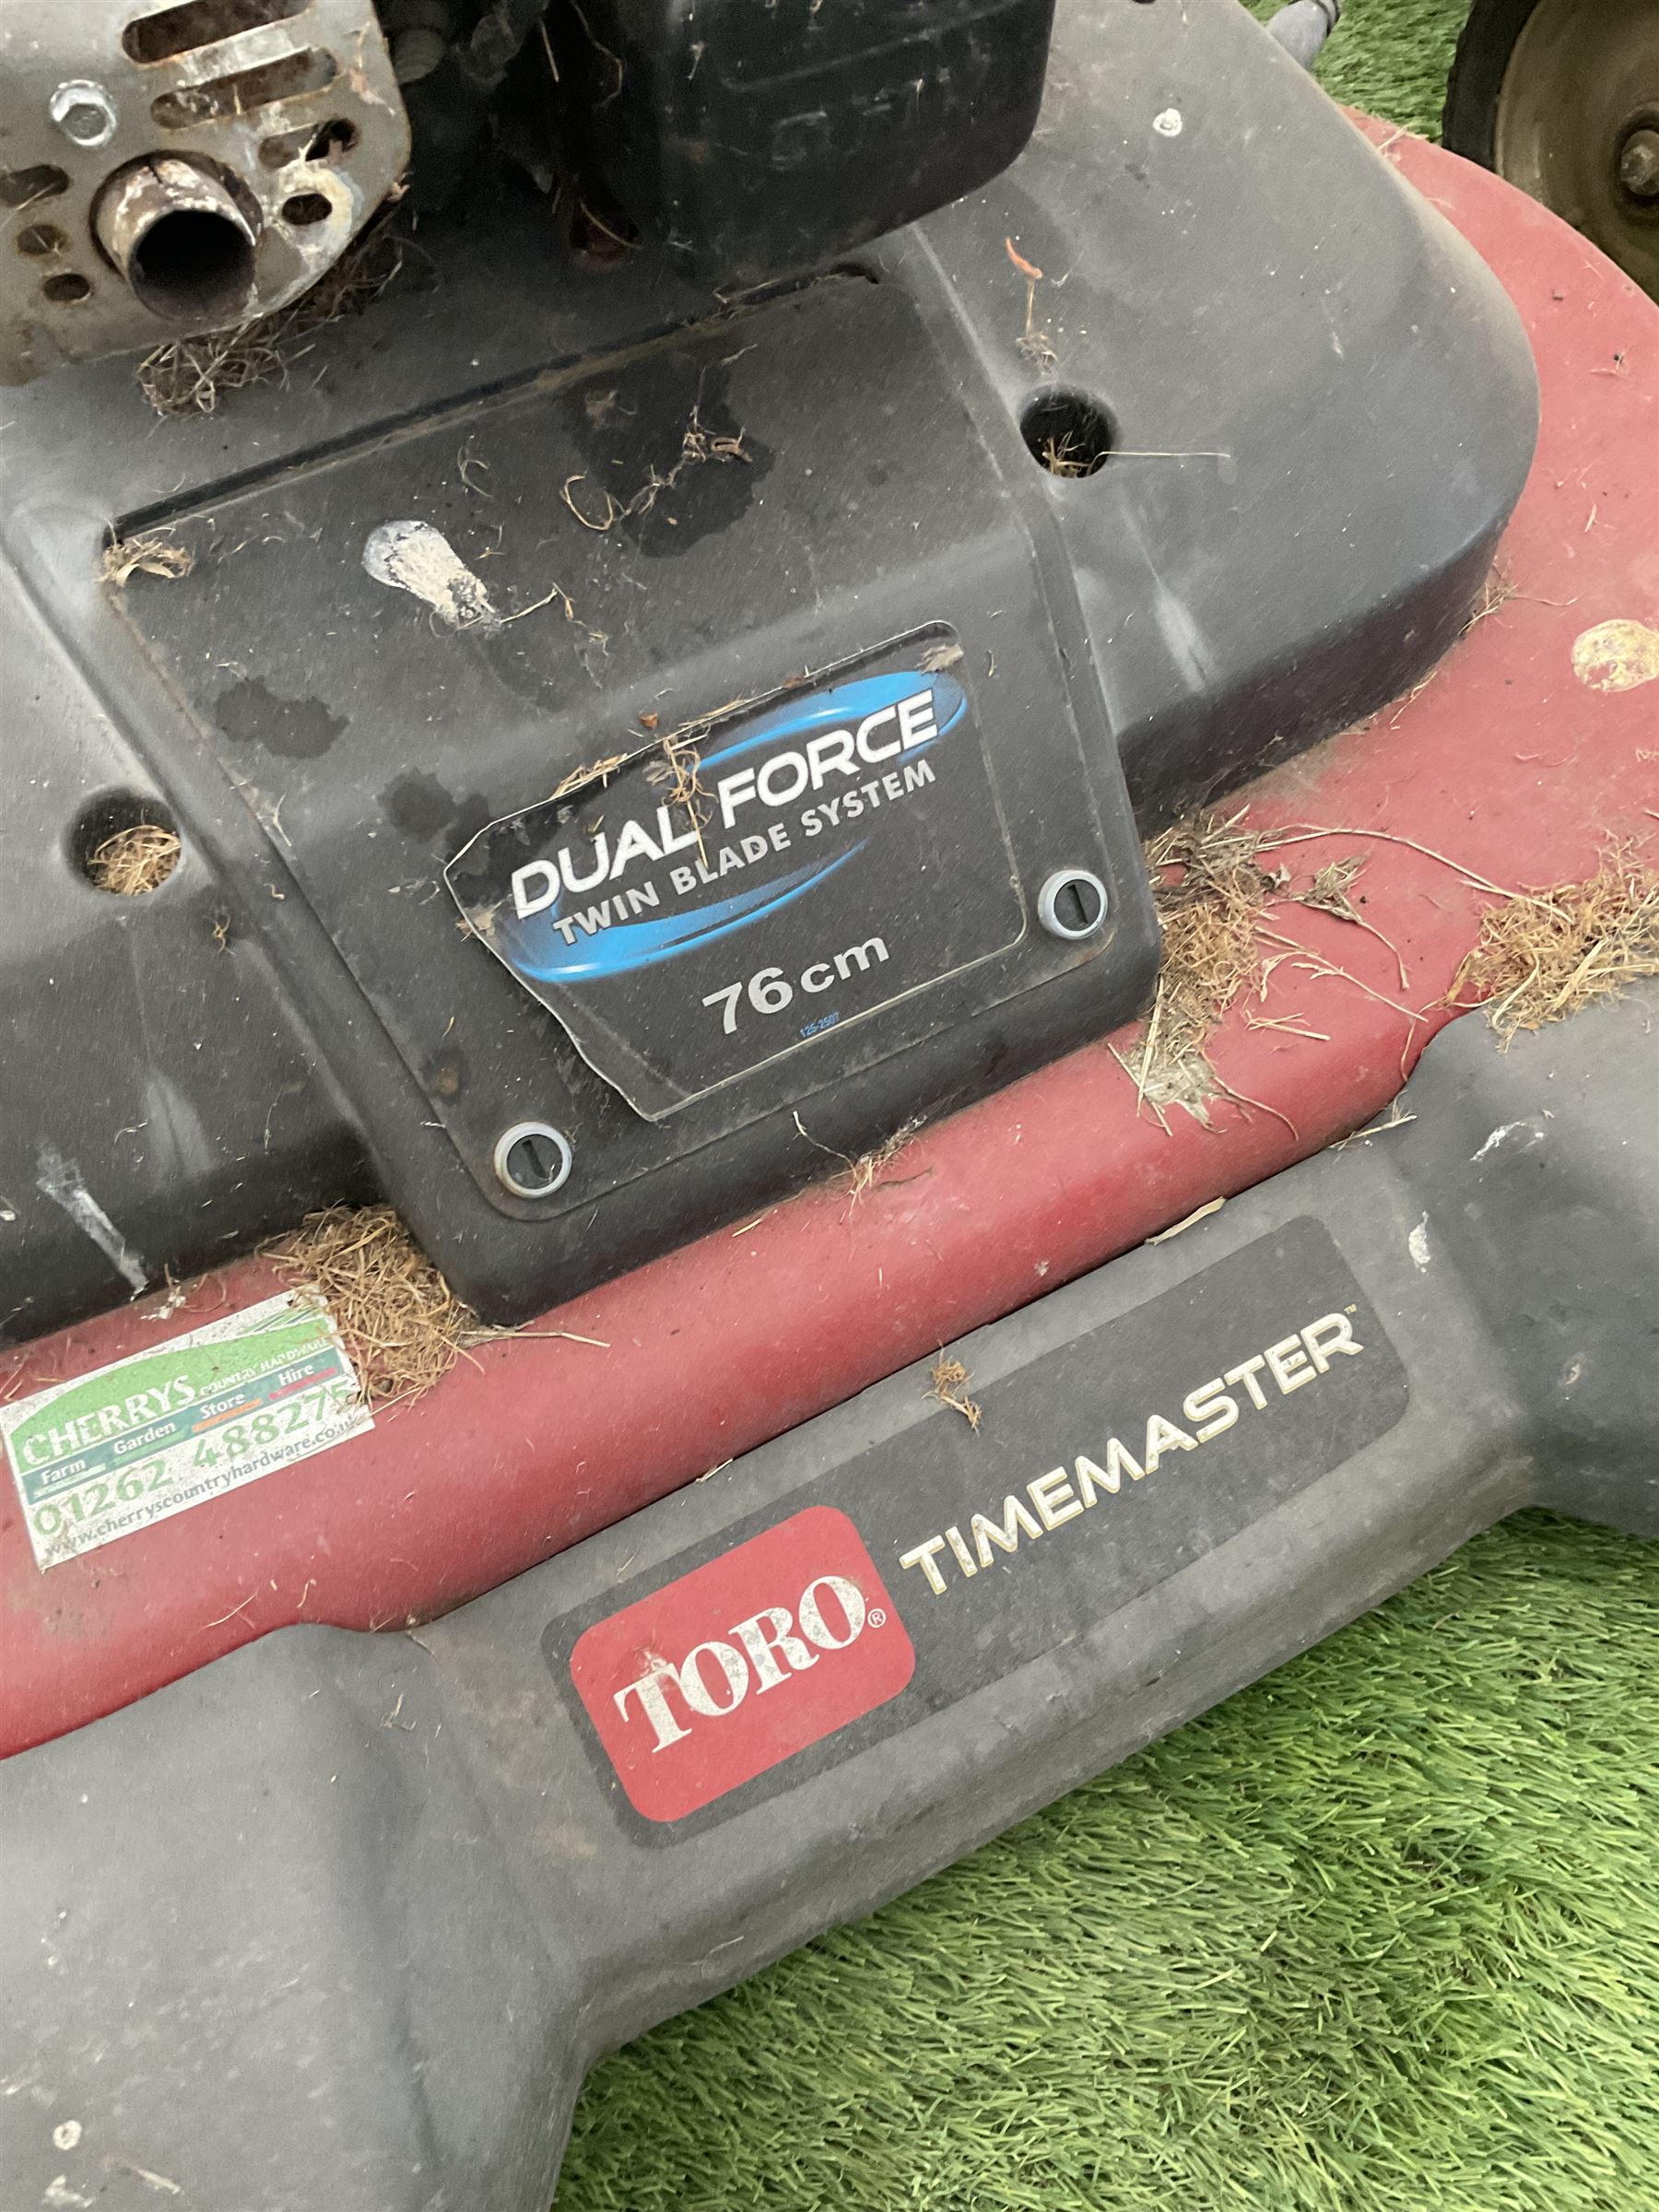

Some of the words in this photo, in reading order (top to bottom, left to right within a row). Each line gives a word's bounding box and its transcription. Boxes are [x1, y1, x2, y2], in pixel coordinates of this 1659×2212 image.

[511, 806, 700, 920] DUAL
[716, 688, 938, 828] FORCE
[552, 882, 661, 946] TWIN
[670, 823, 792, 896] BLADE
[800, 759, 936, 837] SYSTEM
[701, 967, 794, 1035] 76
[800, 935, 890, 994] cm
[23, 1374, 196, 1465] CHERRYS
[41, 1459, 86, 1486] Farm
[113, 1422, 176, 1455] Garden
[200, 1393, 246, 1419] Store
[278, 1363, 314, 1386] Hire
[33, 1459, 174, 1536] 01262
